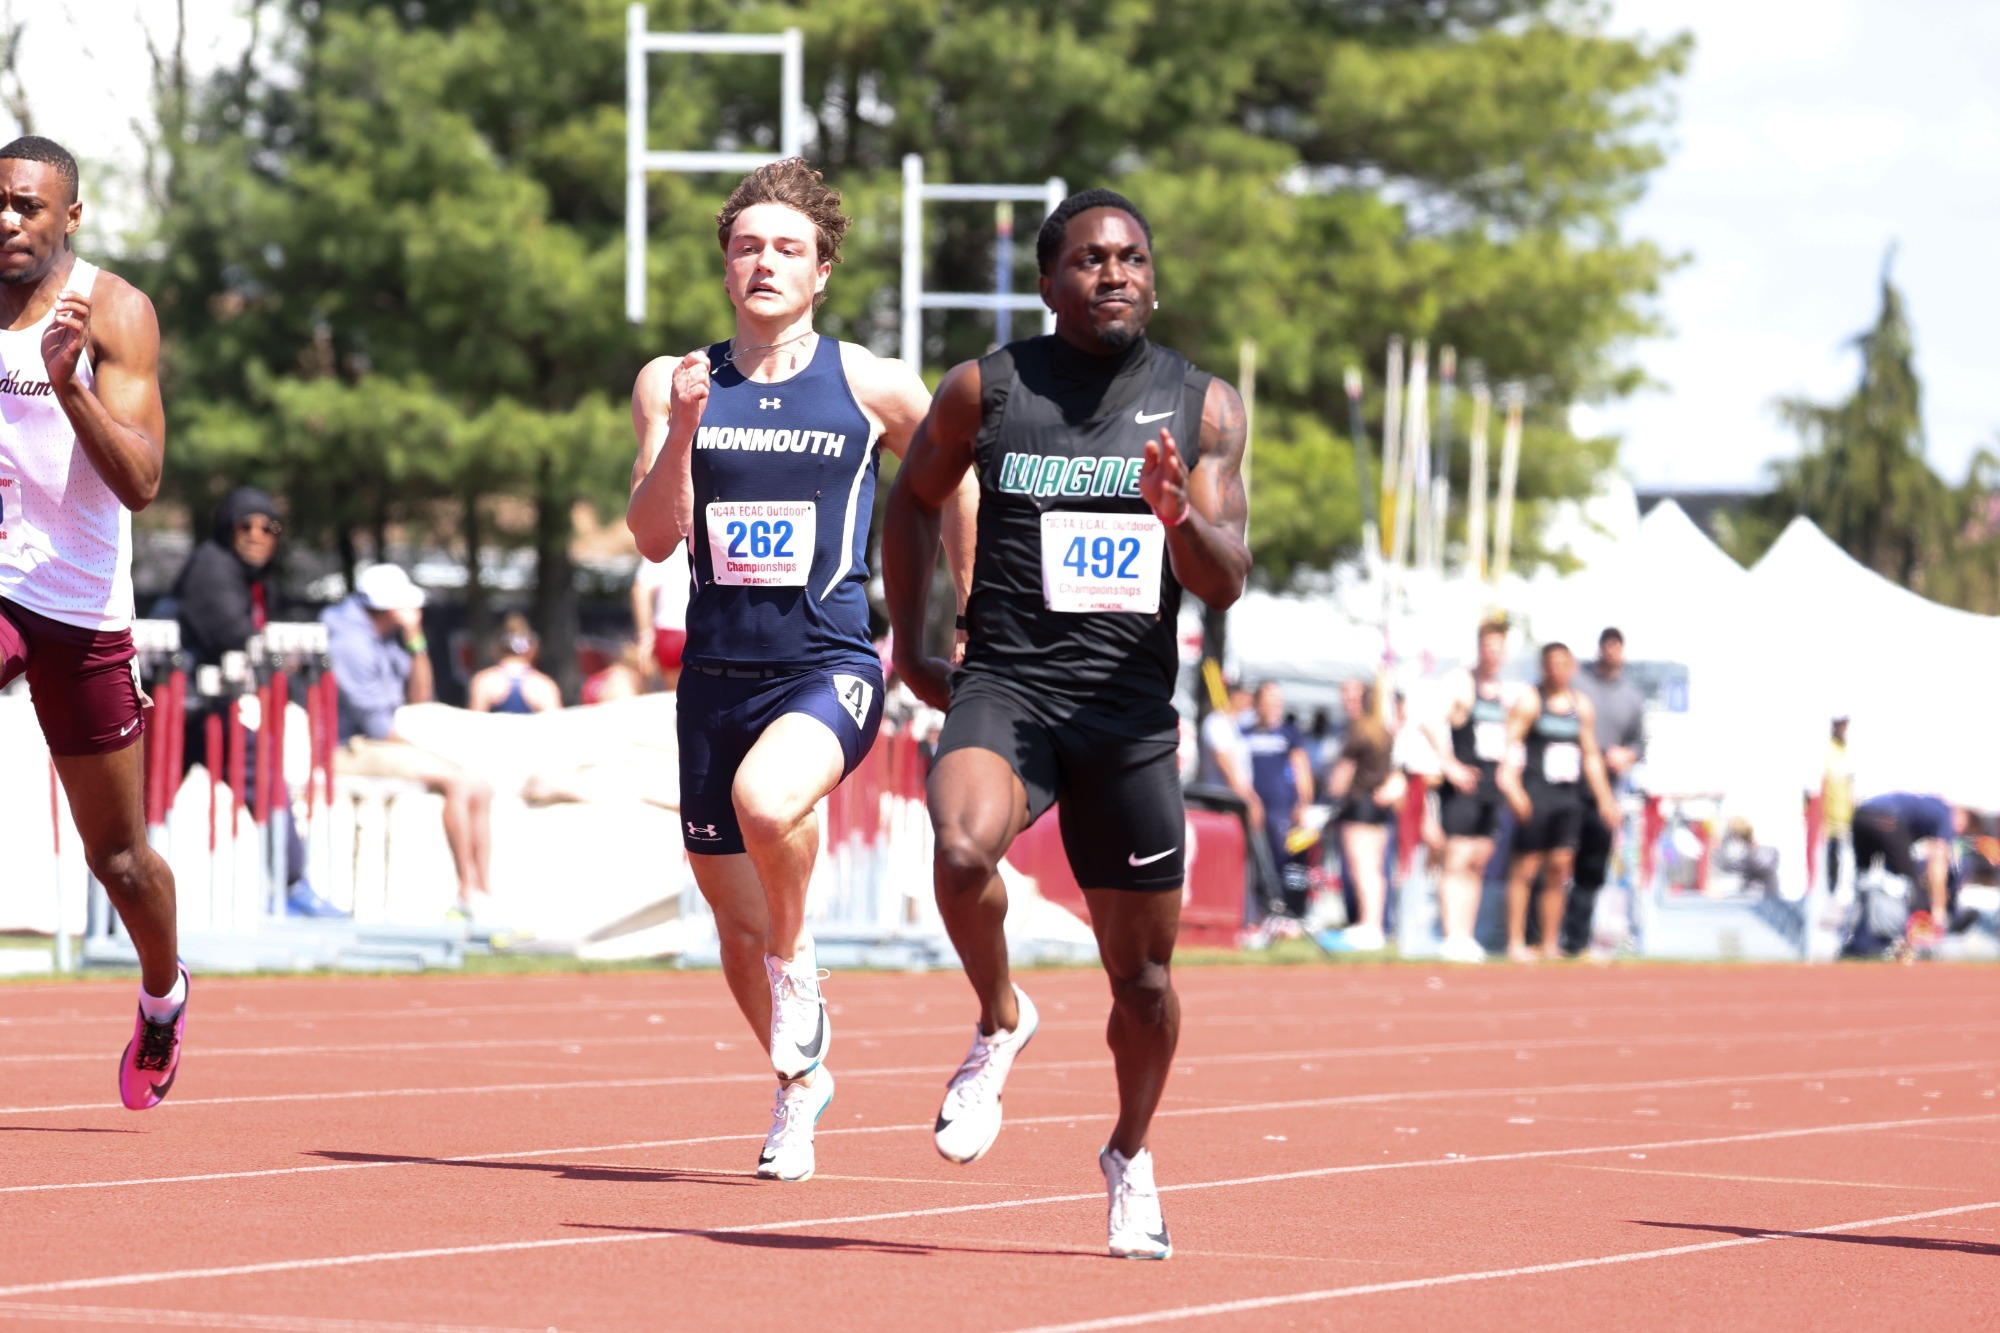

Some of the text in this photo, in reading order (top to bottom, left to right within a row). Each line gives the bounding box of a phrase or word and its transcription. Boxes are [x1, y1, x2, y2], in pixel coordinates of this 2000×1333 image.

[696, 426, 846, 458] MONMOUTH
[999, 452, 1146, 498] WAGNE
[739, 506, 763, 517] ECAC
[767, 505, 807, 517] Outdoor
[726, 520, 794, 558] 262
[1063, 536, 1141, 579] 492
[726, 561, 797, 573] Championships
[845, 679, 864, 720] 4
